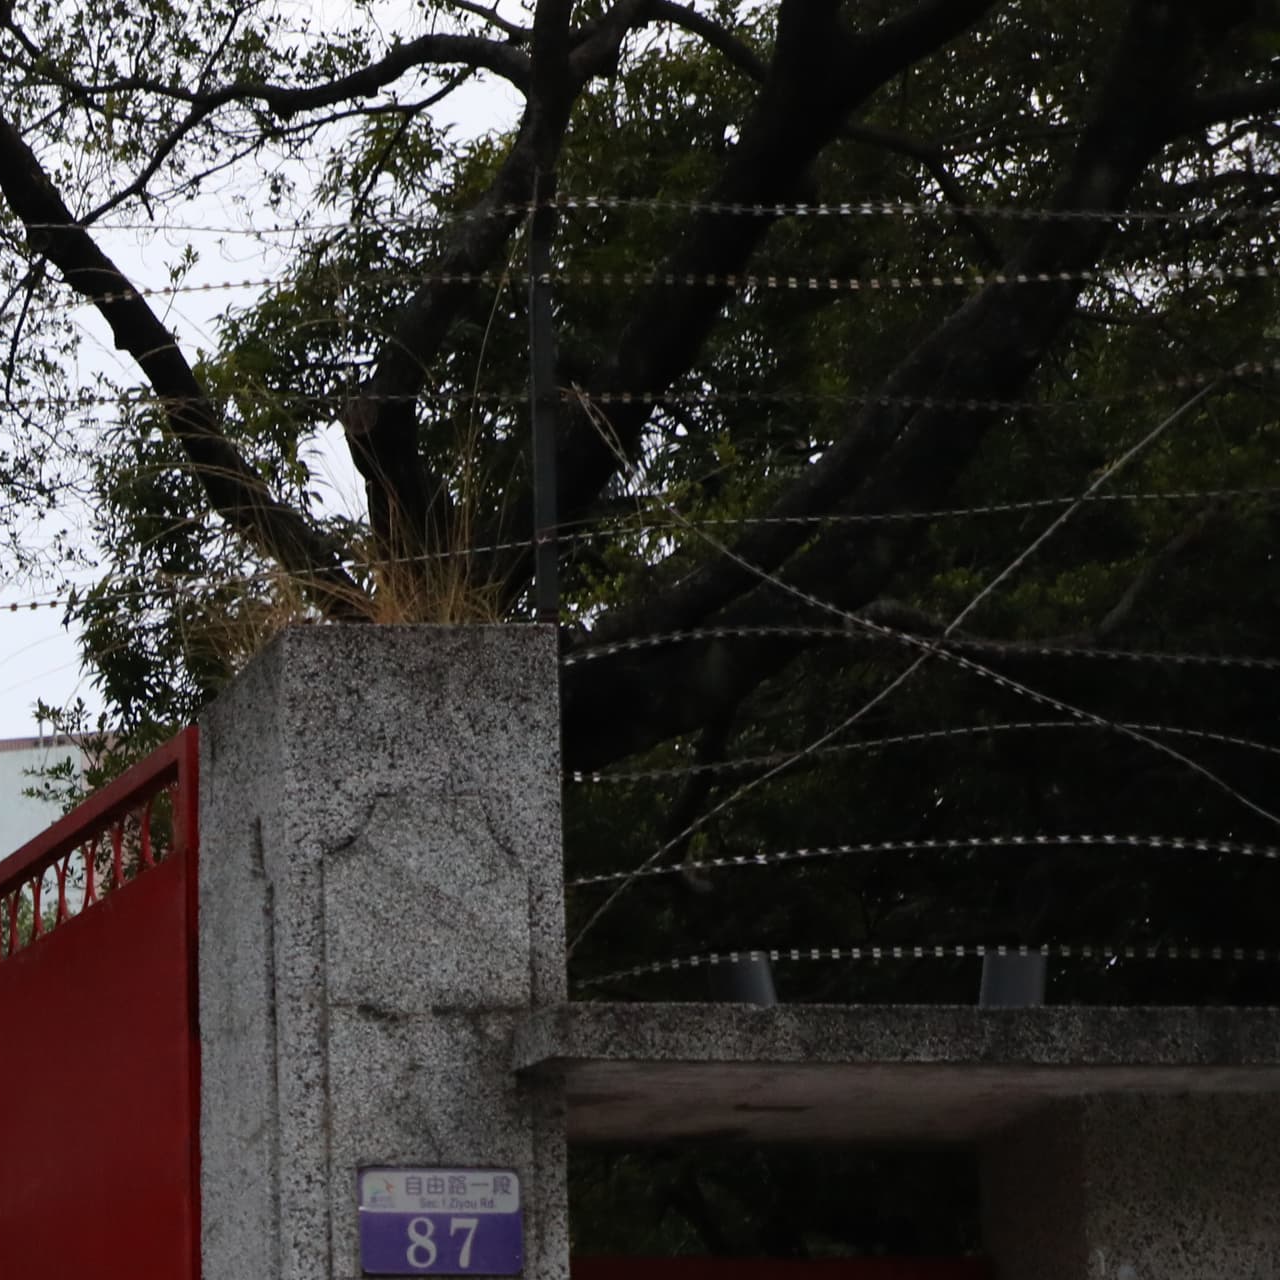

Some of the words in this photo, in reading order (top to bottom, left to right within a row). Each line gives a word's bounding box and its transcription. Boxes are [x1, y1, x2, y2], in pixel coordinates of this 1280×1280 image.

[406, 1175, 512, 1196] 自由路一段
[406, 1217, 479, 1268] 87
